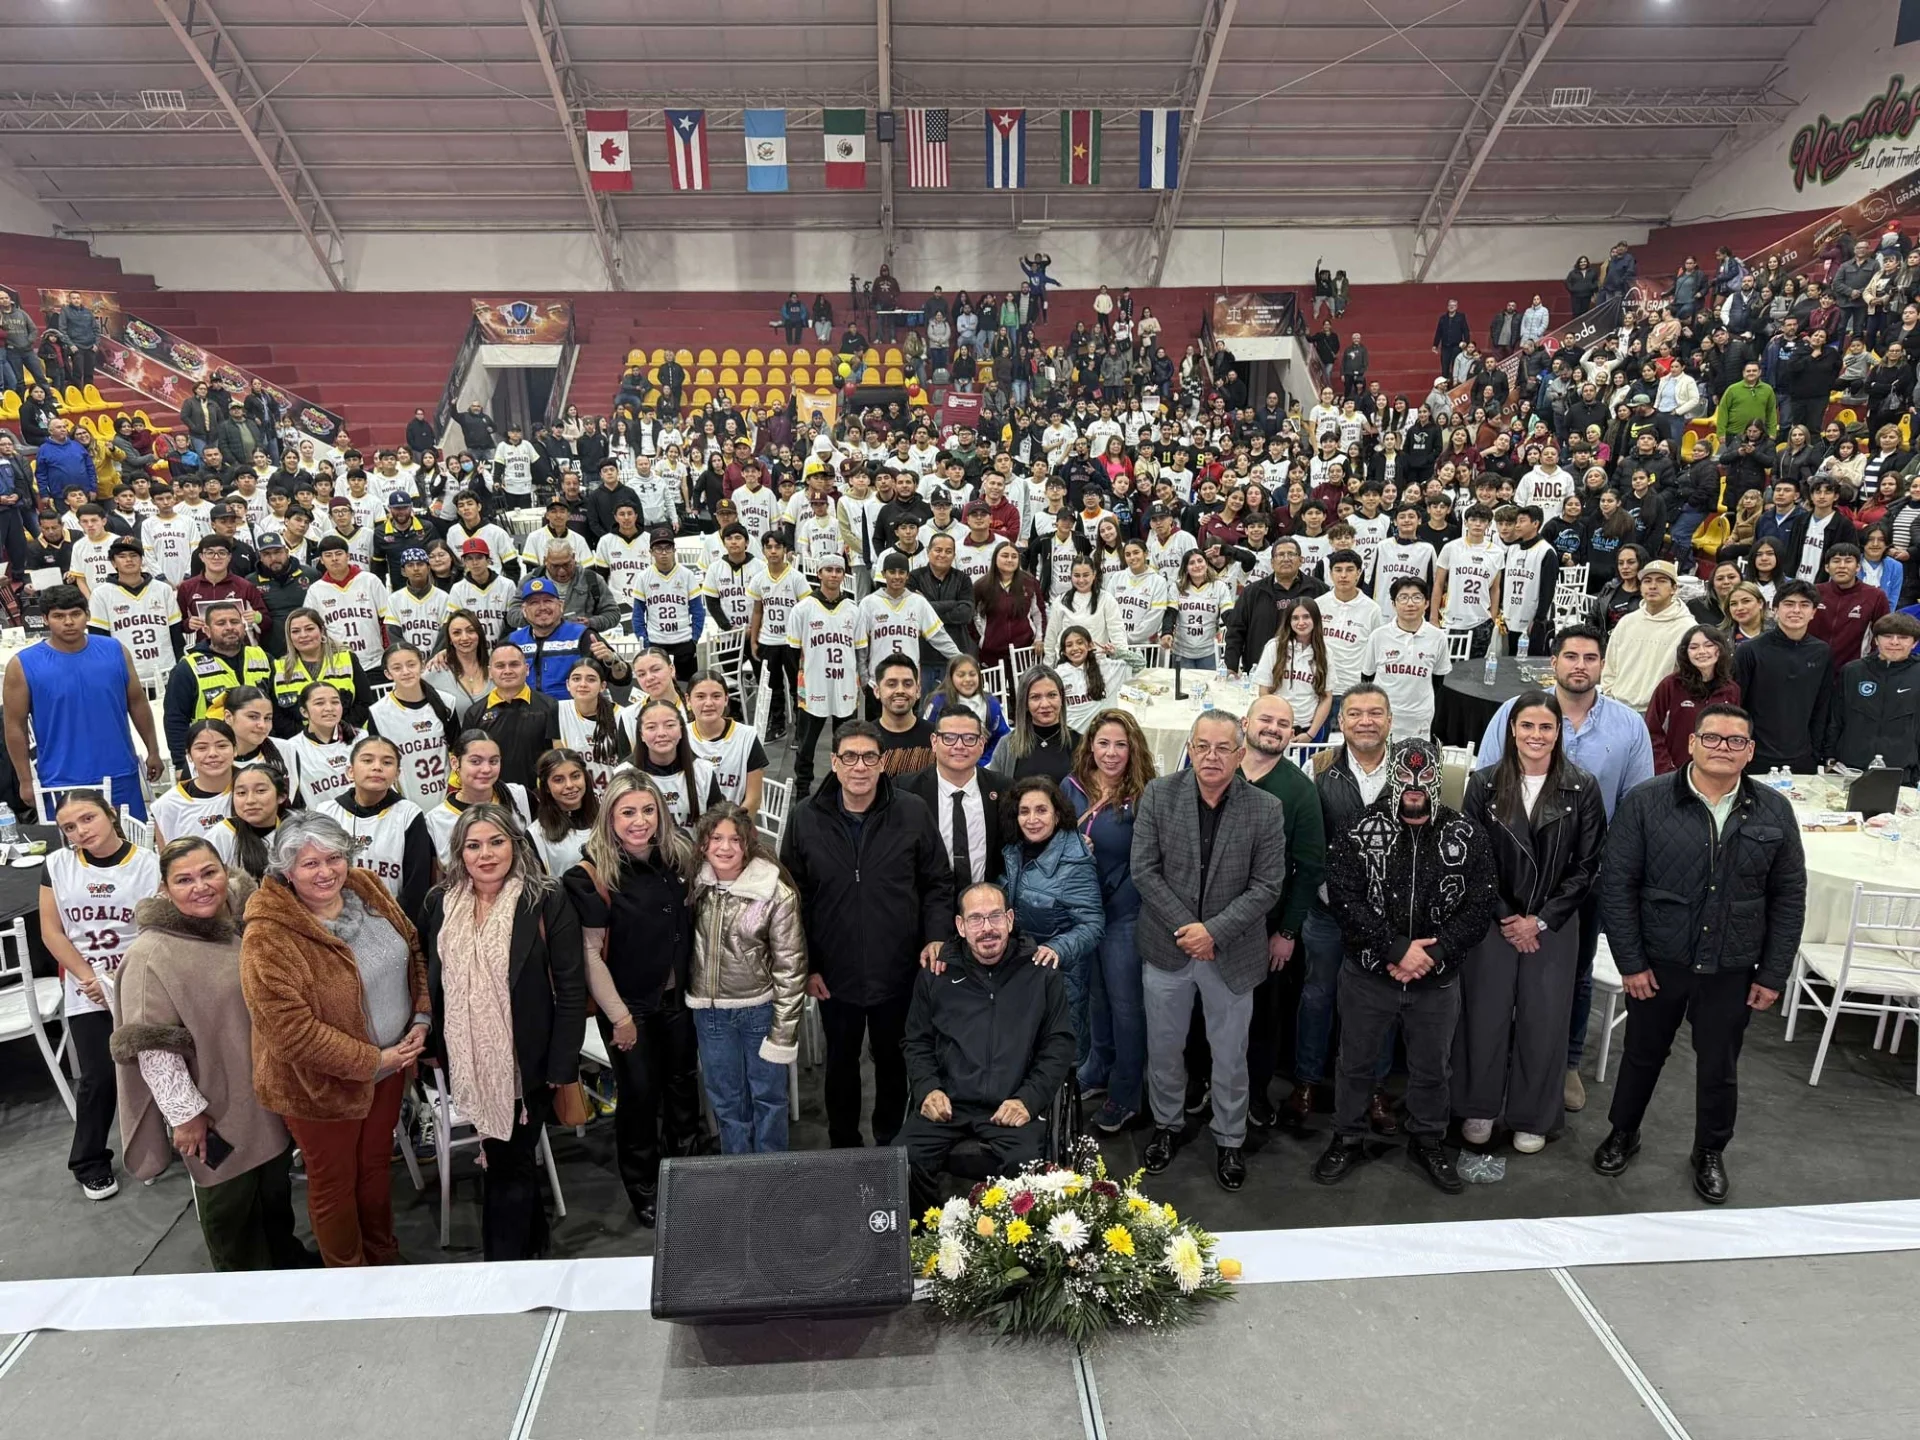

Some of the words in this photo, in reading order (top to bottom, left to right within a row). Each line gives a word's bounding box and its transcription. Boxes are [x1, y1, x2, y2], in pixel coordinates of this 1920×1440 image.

[1861, 148, 1874, 170] La
[1533, 482, 1562, 498] NOG
[747, 516, 760, 528] 32
[154, 531, 186, 540] NOGALES
[164, 539, 176, 550] 13
[95, 564, 107, 575] 18
[1383, 564, 1420, 577] NOGALES
[626, 572, 636, 585] 7
[622, 587, 634, 598] SO
[719, 586, 746, 599] NOGA
[1463, 579, 1482, 594] 22
[1512, 580, 1524, 595] 17
[646, 593, 687, 607] NOGALES
[731, 599, 747, 613] 15
[1117, 595, 1150, 610] OGALES
[1463, 595, 1481, 605] SON
[658, 606, 678, 620] 22
[1122, 608, 1134, 620] 16
[1178, 602, 1217, 613] NOGALES
[324, 607, 374, 624] NOGALES
[730, 614, 750, 628] SON
[768, 608, 785, 622] 03
[1188, 615, 1203, 625] 24
[114, 614, 168, 632] NOGALES
[344, 622, 359, 637] 11
[659, 621, 679, 633] SON
[769, 623, 786, 635] SON
[1124, 622, 1135, 632] ON
[131, 628, 157, 645] 23
[873, 624, 918, 640] NOGALES
[1187, 626, 1204, 636] SON
[1322, 626, 1358, 644] OGALES
[343, 640, 367, 652] ON
[412, 632, 432, 646] 05
[810, 632, 854, 649] NOGALES
[135, 646, 160, 660] SON
[892, 639, 903, 654] 5
[826, 647, 844, 665] 12
[825, 667, 845, 680] SON
[1283, 669, 1317, 685] OGALE
[1385, 663, 1429, 679] NOGALES
[414, 754, 445, 780] 32
[310, 775, 353, 795] NOGA
[420, 778, 447, 796] SON
[356, 857, 402, 880] ALES
